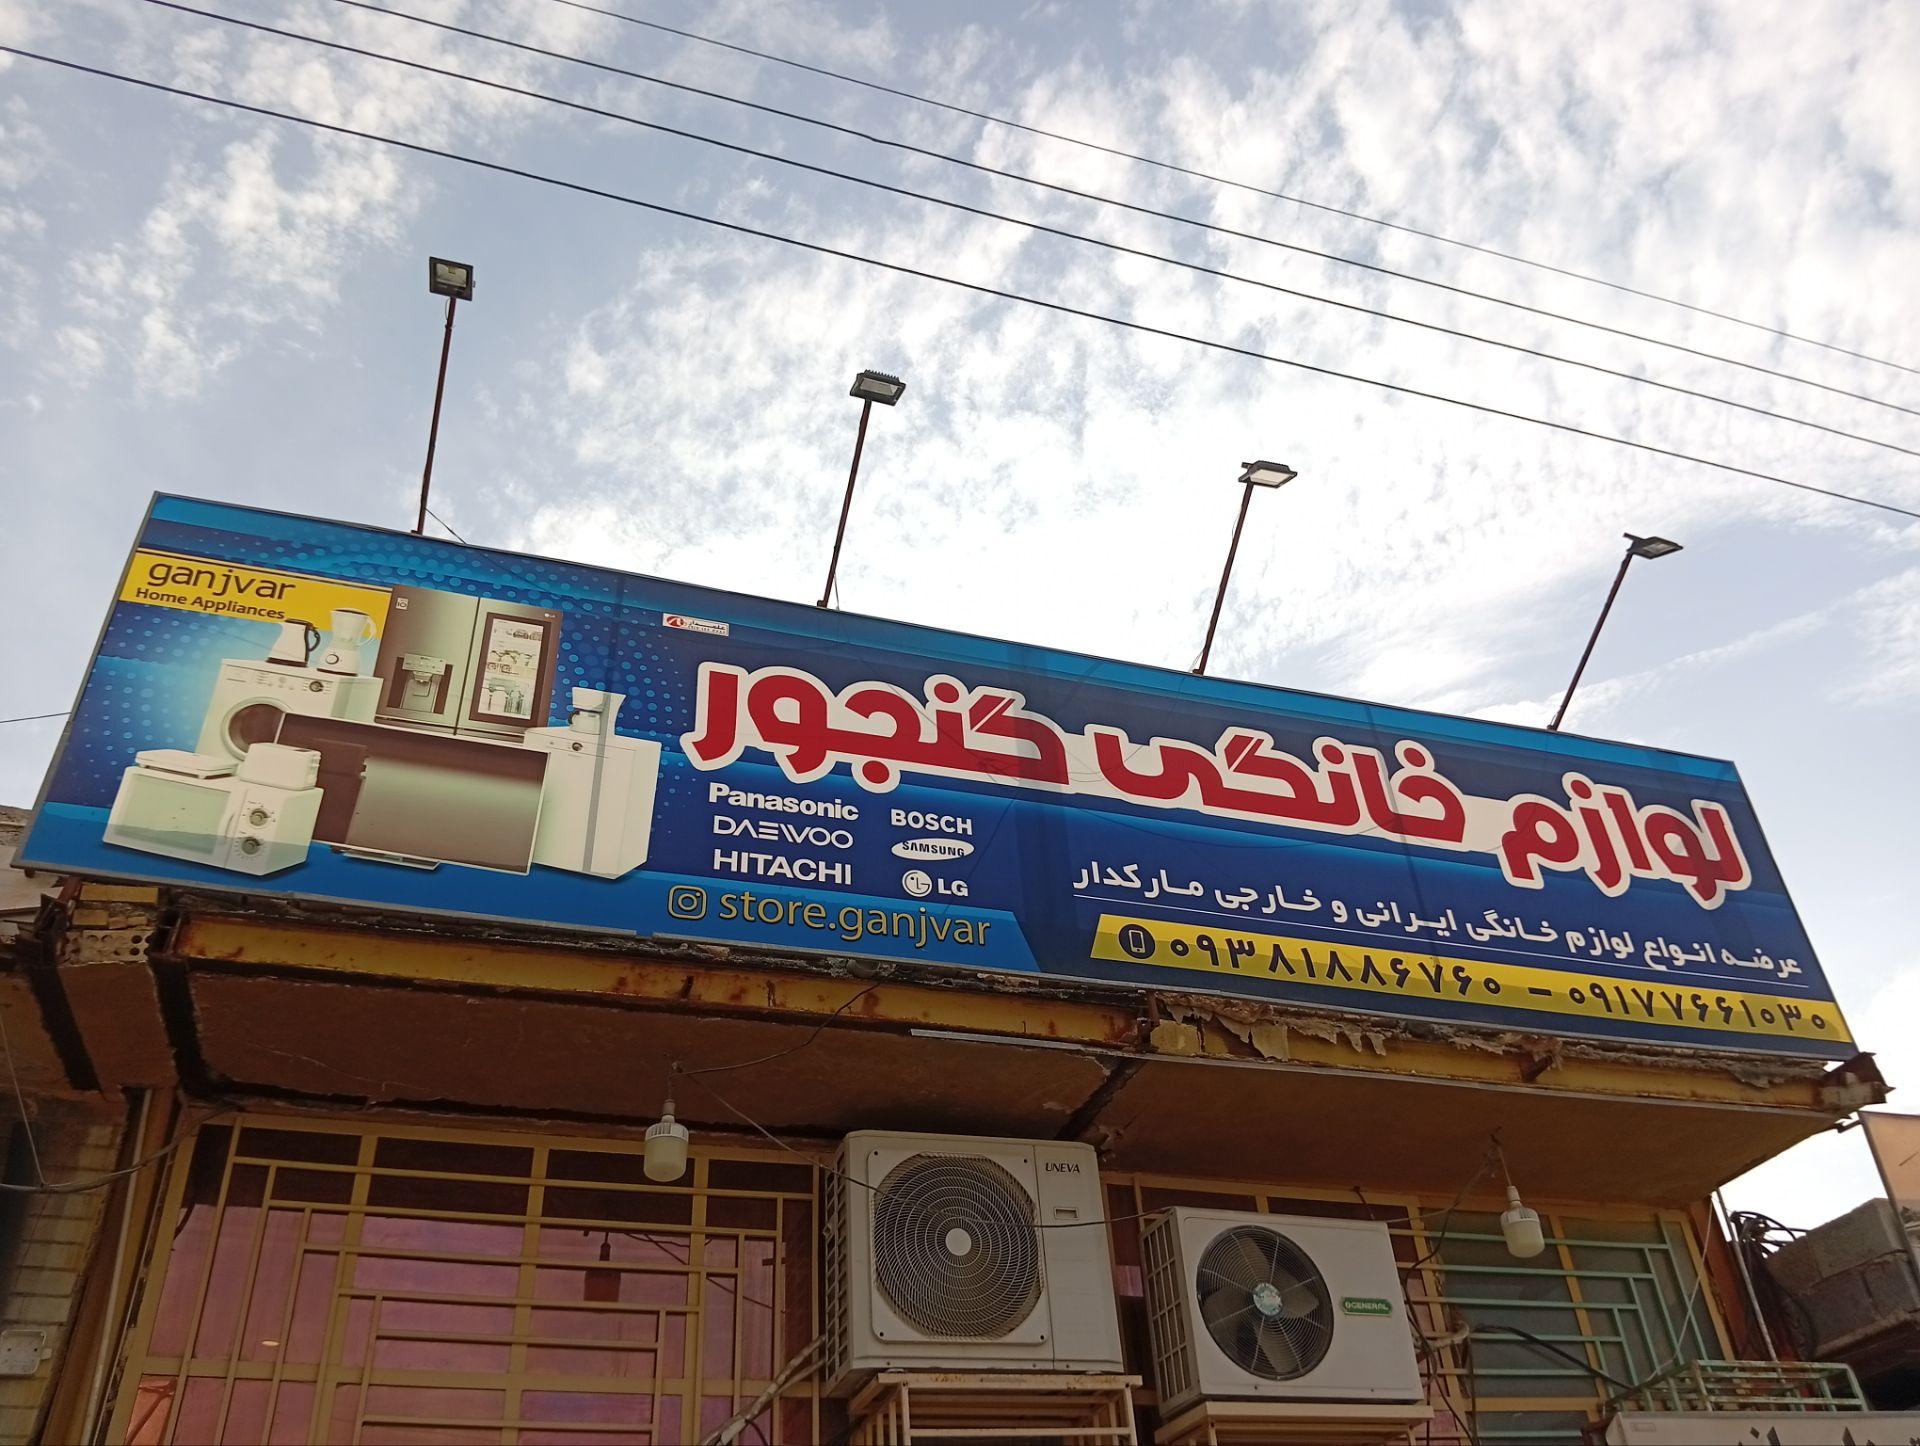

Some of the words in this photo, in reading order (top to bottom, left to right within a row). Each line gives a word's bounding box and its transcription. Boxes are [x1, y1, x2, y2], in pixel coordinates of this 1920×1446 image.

[147, 562, 296, 600] ganjvar
[135, 587, 188, 605] Home
[190, 596, 285, 619] Appliances
[690, 667, 1072, 788] گنجور
[708, 782, 859, 821] Panasonic
[1093, 731, 1468, 845] خانگی
[713, 815, 854, 849] DAEWOO
[890, 808, 973, 836] BOSCH
[901, 840, 966, 858] SAMSUNG
[1500, 778, 1746, 903] لوازم
[713, 848, 852, 885] HITACHI
[937, 878, 969, 897] LG
[1214, 884, 1322, 915] خارجی
[718, 890, 991, 948] store.ganjvar
[1331, 899, 1348, 924] و
[1355, 900, 1457, 938] ایرانی
[1465, 909, 1559, 942] خانگی
[1564, 926, 1635, 960] لوازم
[1643, 936, 1717, 972] انواع
[1720, 948, 1803, 979] عرضه
[1044, 1162, 1081, 1173] UNEVA
